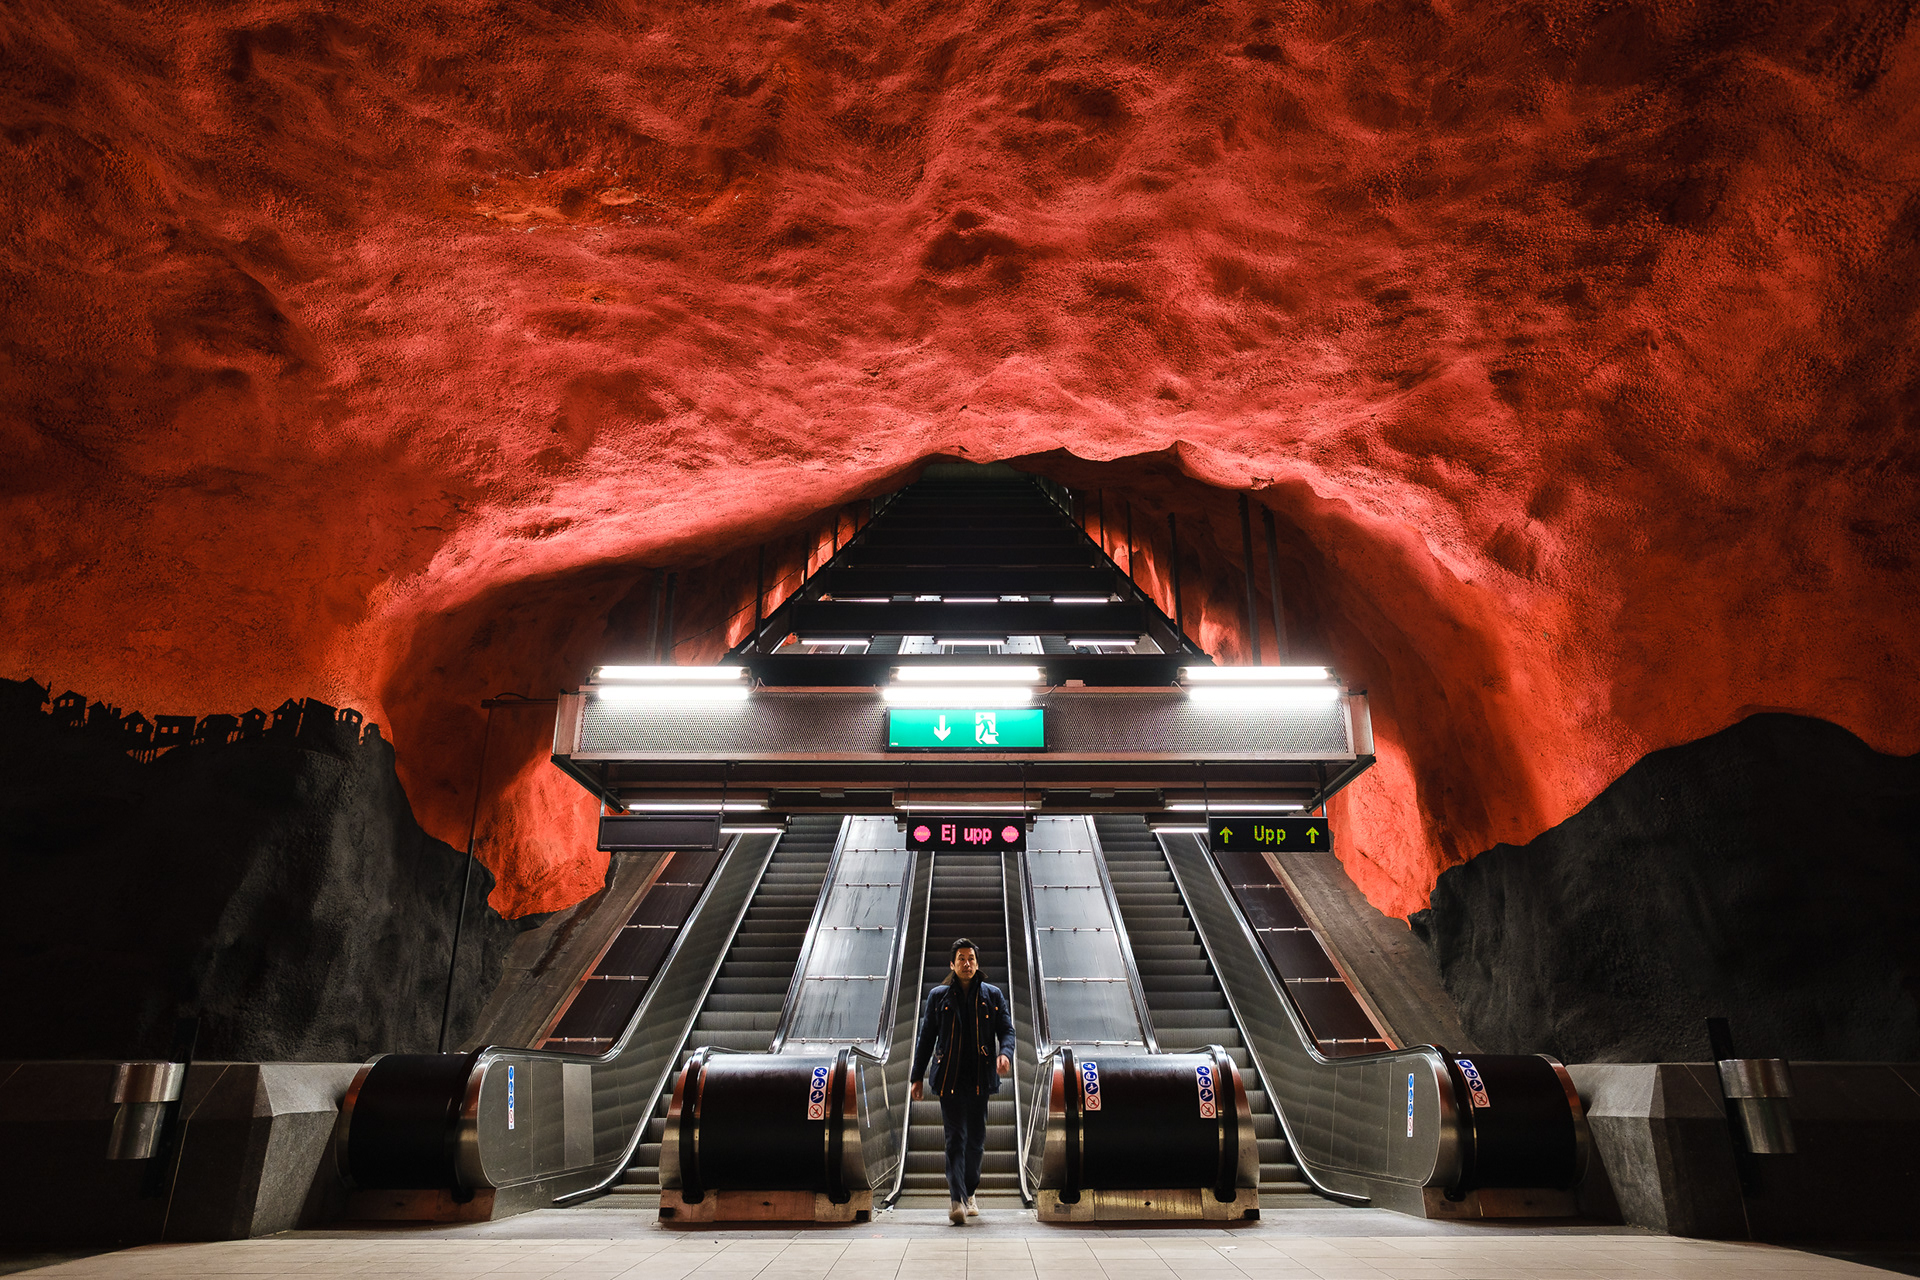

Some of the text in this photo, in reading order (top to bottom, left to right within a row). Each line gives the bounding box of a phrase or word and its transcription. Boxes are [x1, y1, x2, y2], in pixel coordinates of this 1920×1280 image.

[941, 824, 992, 845] Ej upp
[1254, 825, 1286, 845] Upp
